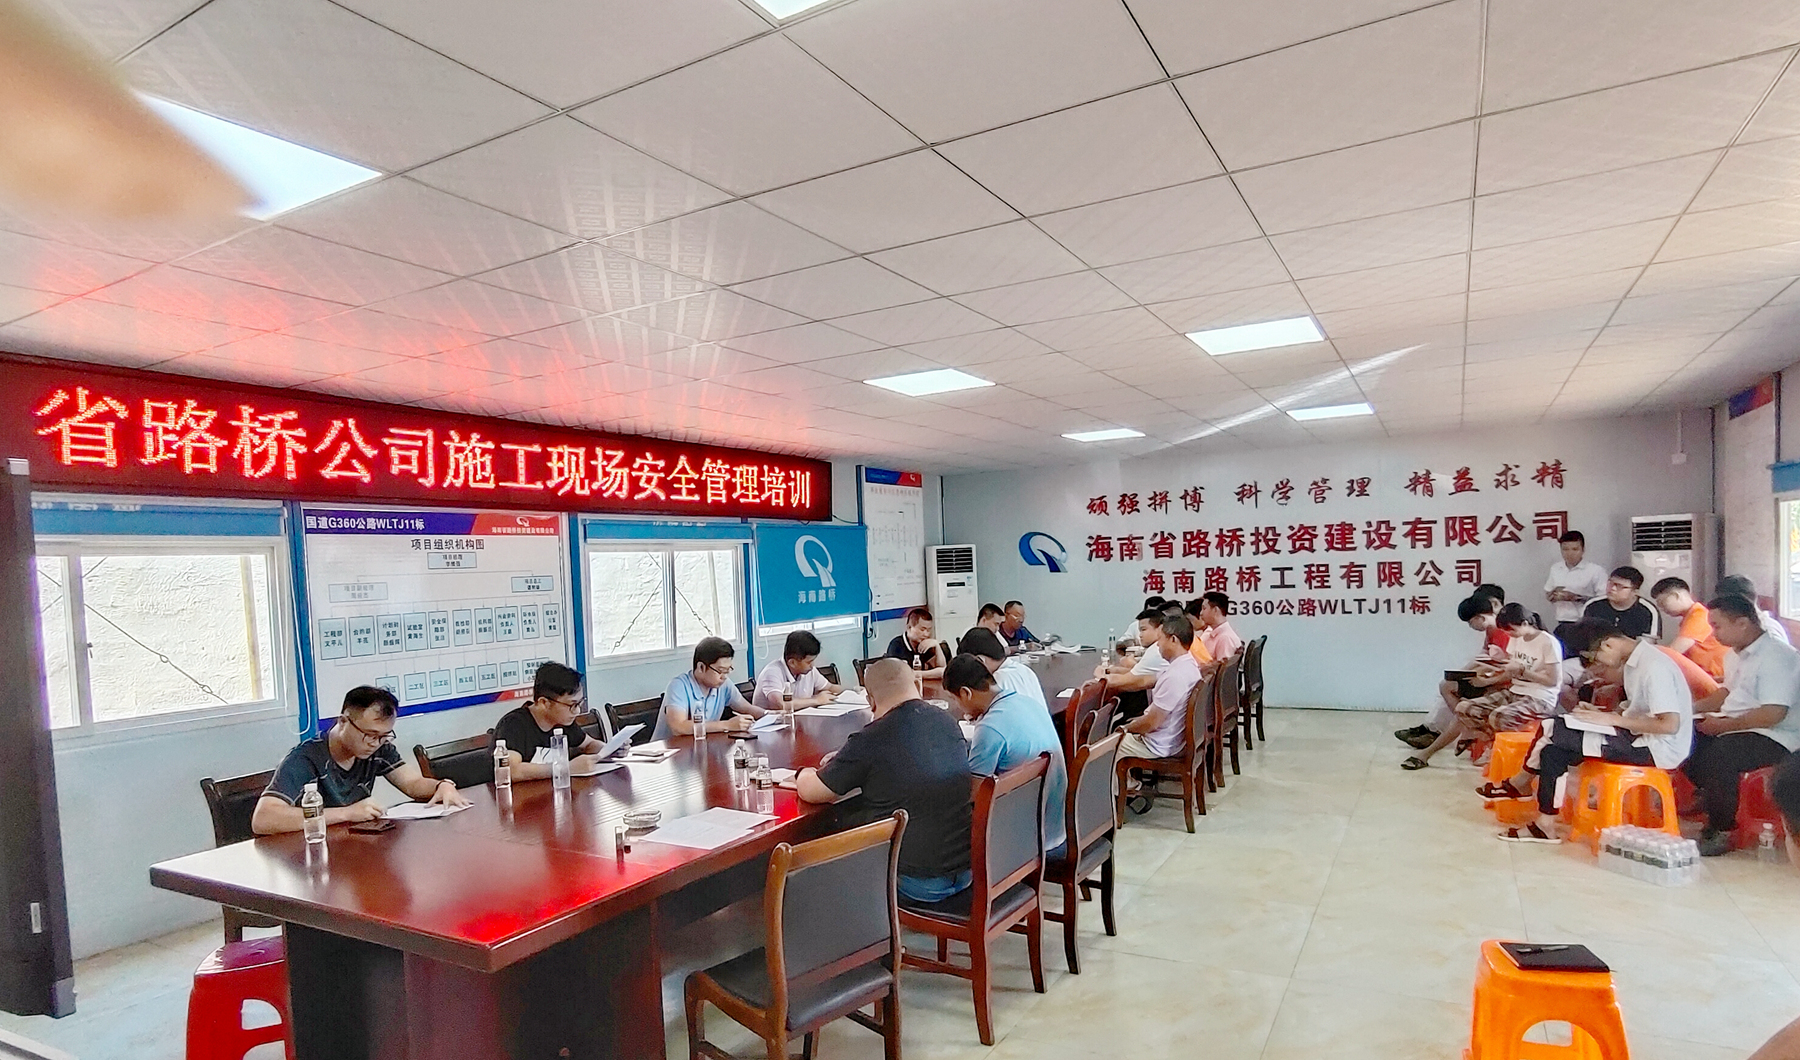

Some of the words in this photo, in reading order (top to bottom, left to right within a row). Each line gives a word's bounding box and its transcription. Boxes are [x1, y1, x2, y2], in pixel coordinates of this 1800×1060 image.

[32, 385, 813, 509] 省路桥公司施工现场安全管理培训
[1233, 477, 1371, 509] 科学管理
[1404, 459, 1567, 498] 精益求精
[306, 515, 425, 530] 国道G360公路WLTJ11标
[1086, 511, 1568, 562] 海南省路桥投资建设有限公司
[411, 538, 485, 550] 项目组织机构图
[1142, 559, 1482, 594] 海南路桥工程有限公司
[797, 589, 836, 603] 海南路桥
[1186, 595, 1431, 617] G360公路WLTJ11标
